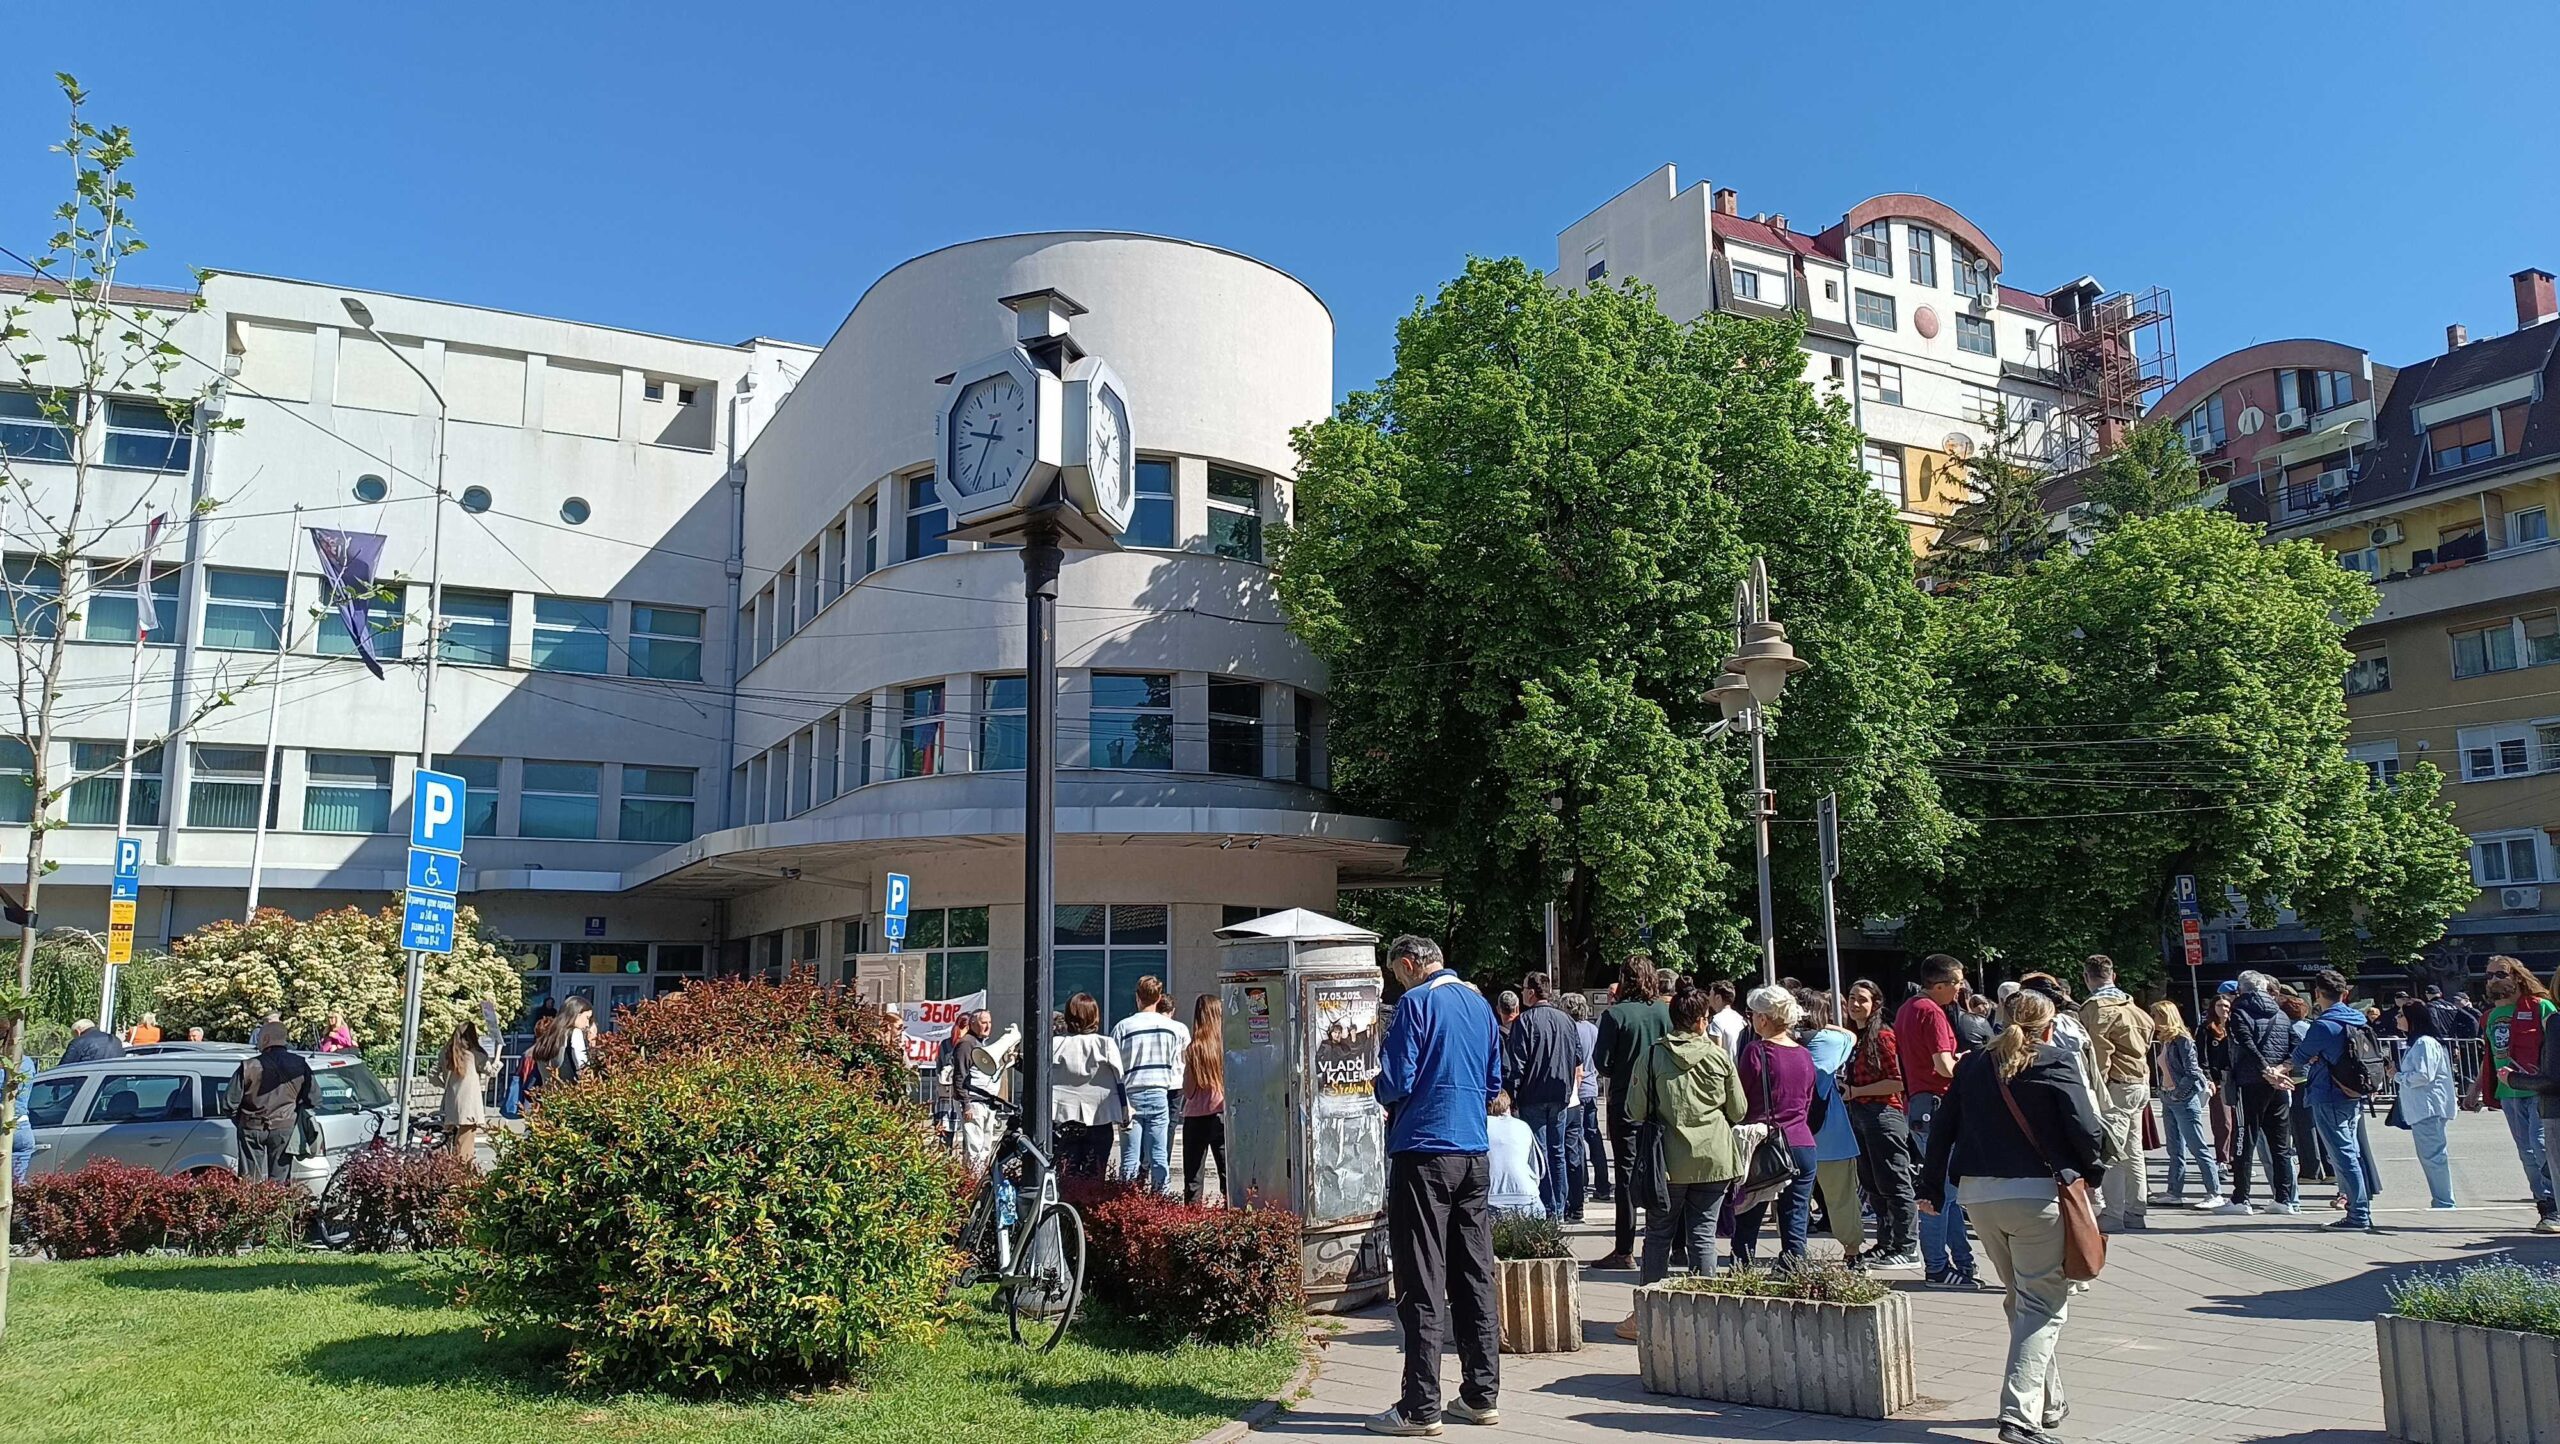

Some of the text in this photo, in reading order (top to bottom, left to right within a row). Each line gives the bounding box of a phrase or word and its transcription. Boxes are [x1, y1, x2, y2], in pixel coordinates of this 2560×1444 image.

[424, 781, 453, 839] P
[120, 842, 136, 874] P
[891, 879, 904, 911] P
[2180, 878, 2192, 900] P
[920, 1002, 962, 1024] ЗБОР
[1318, 1059, 1363, 1073] VLADO
[2236, 1126, 2245, 1156] adidas
